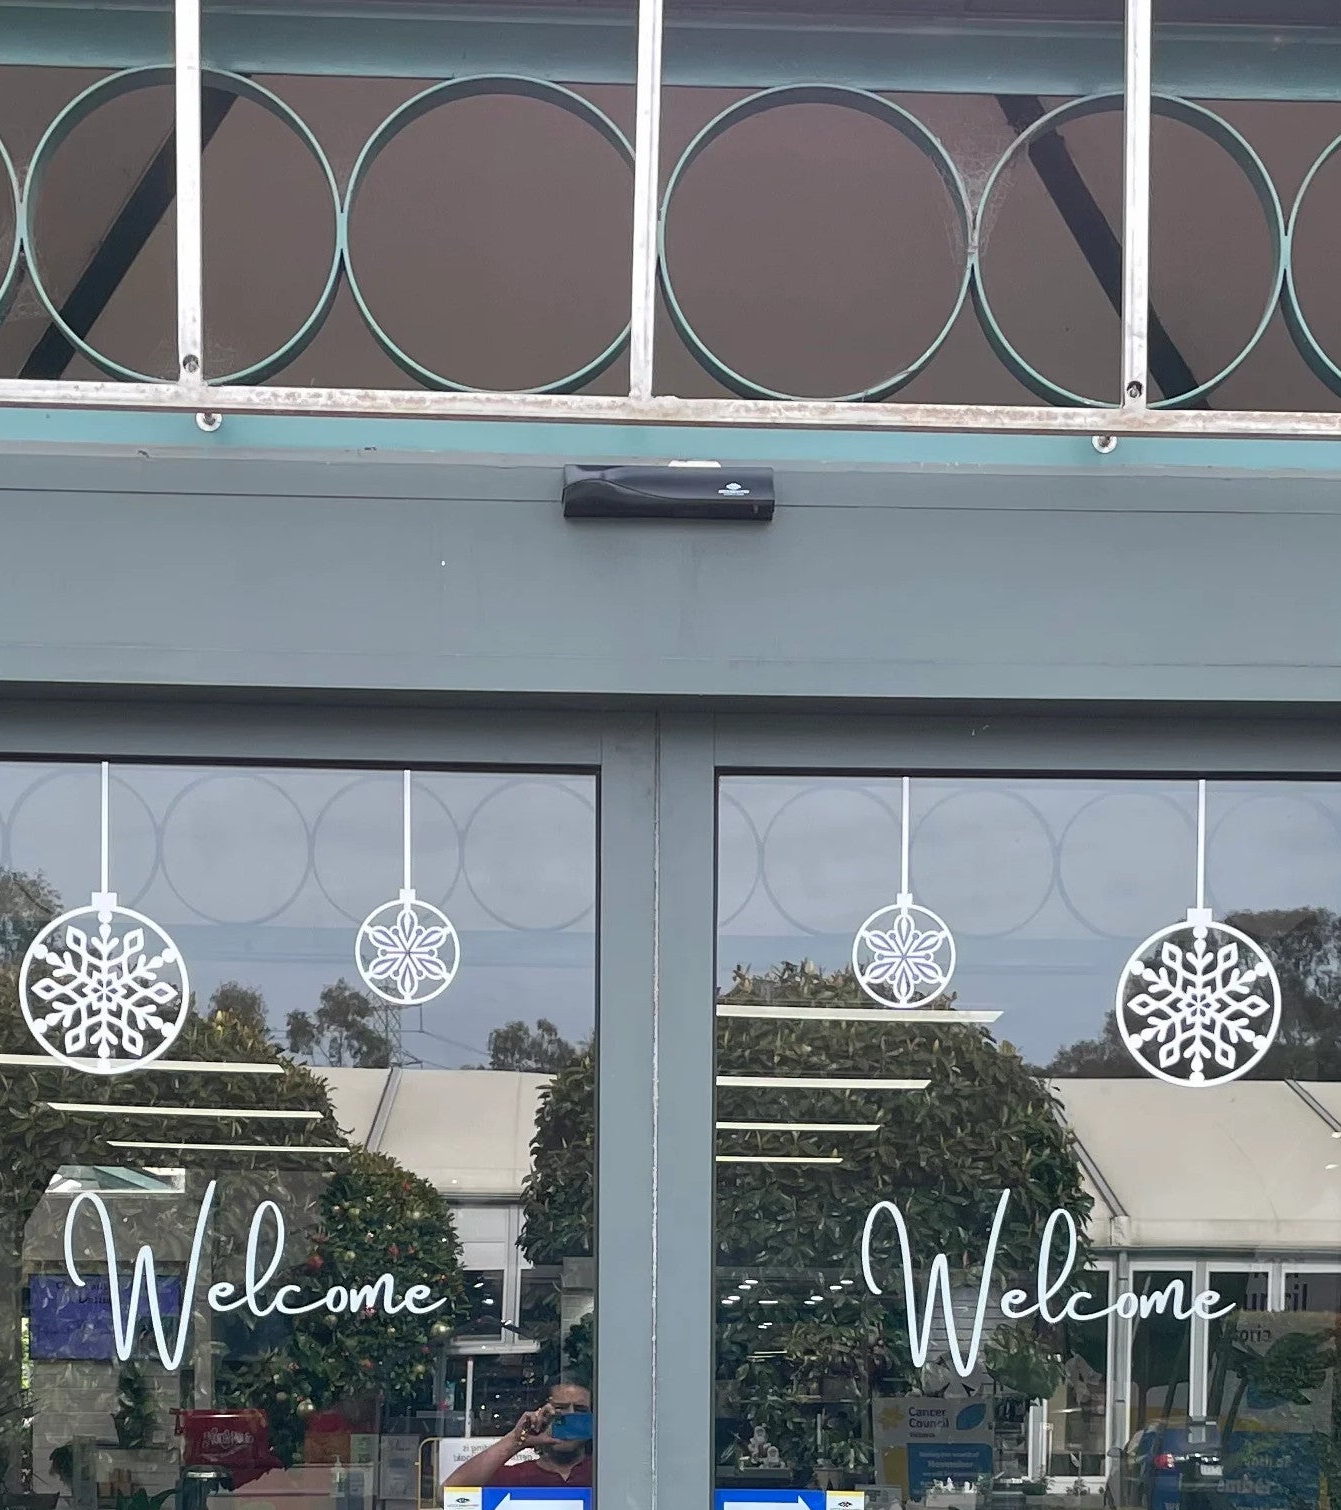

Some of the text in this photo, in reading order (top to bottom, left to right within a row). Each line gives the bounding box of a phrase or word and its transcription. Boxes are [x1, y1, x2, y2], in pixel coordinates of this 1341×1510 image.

[63, 1180, 447, 1371] Welcome
[861, 1188, 1237, 1377] Welcome
[909, 1406, 947, 1417] Cancer
[909, 1418, 950, 1429] Council
